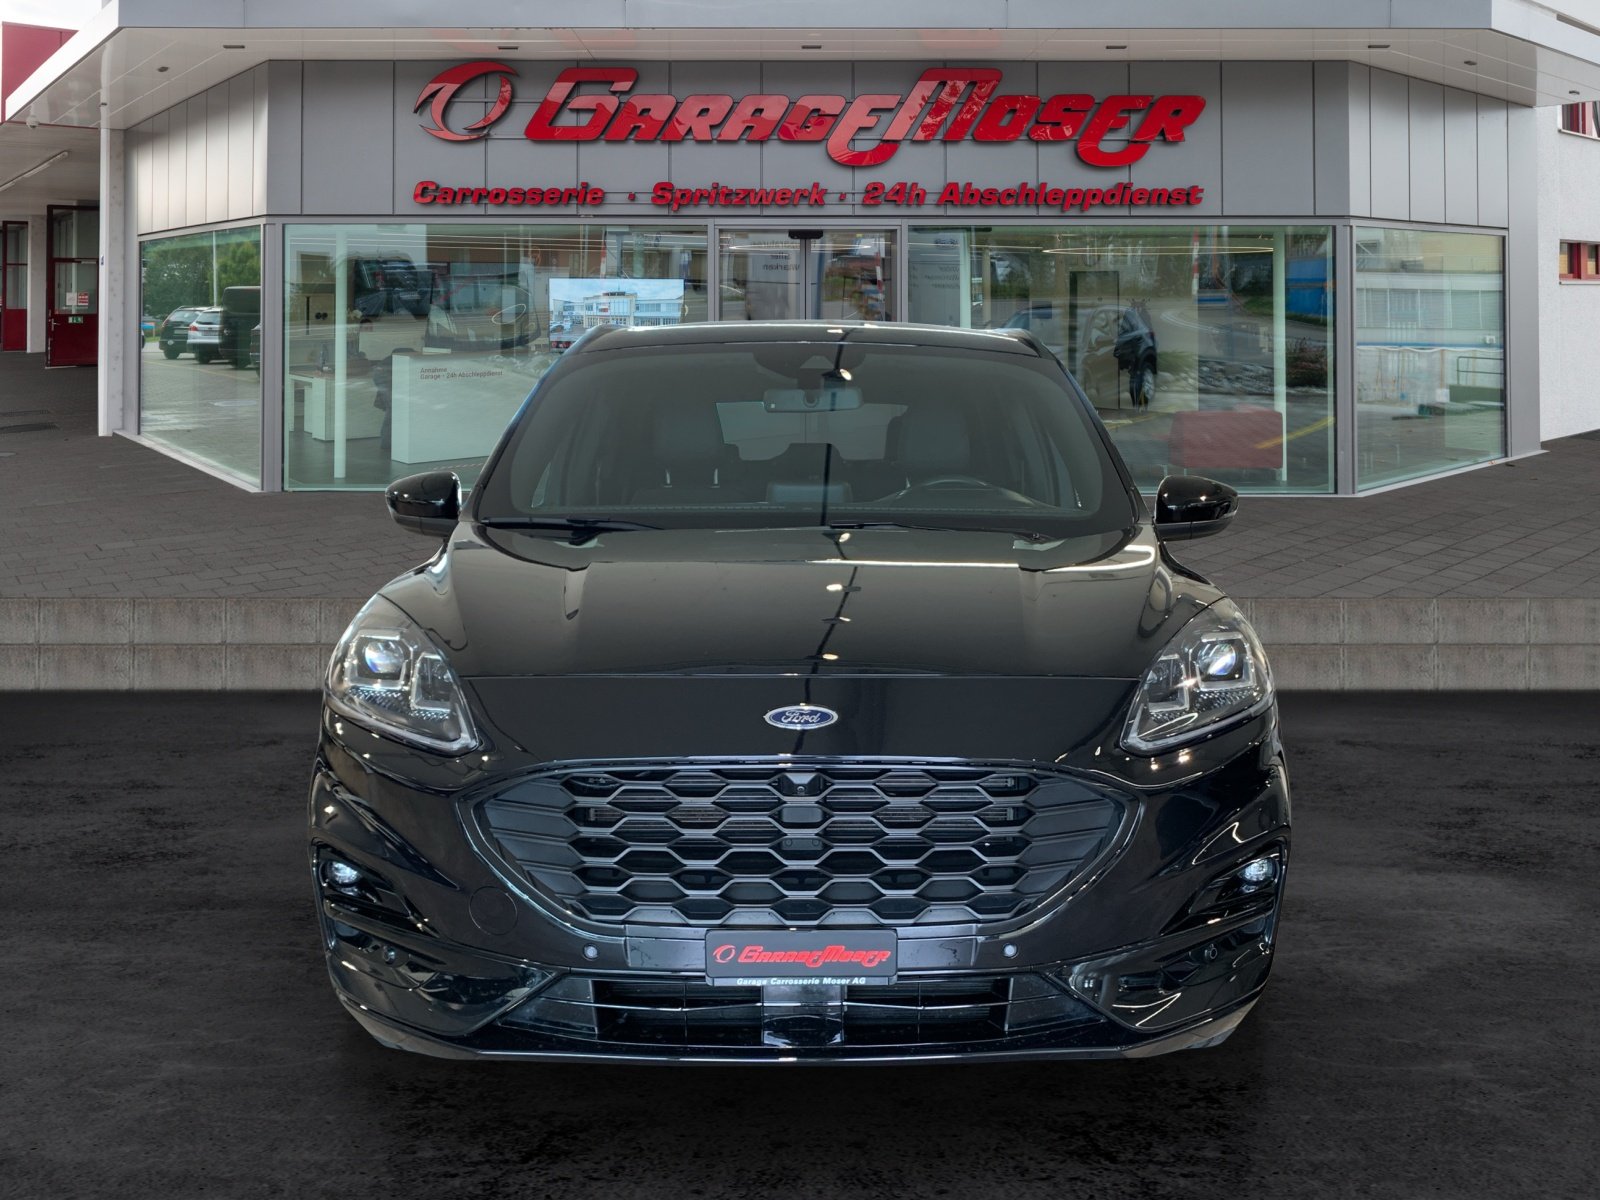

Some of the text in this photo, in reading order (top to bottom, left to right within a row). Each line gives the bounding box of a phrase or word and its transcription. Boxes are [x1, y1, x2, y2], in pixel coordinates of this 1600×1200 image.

[413, 181, 1204, 212] Carrosserie Spritzwerk 24h Abschleppdienst
[458, 370, 503, 378] Abschleppdienst
[781, 709, 821, 723] Ford
[736, 977, 866, 987] Garage Carrosserie Moser AG
